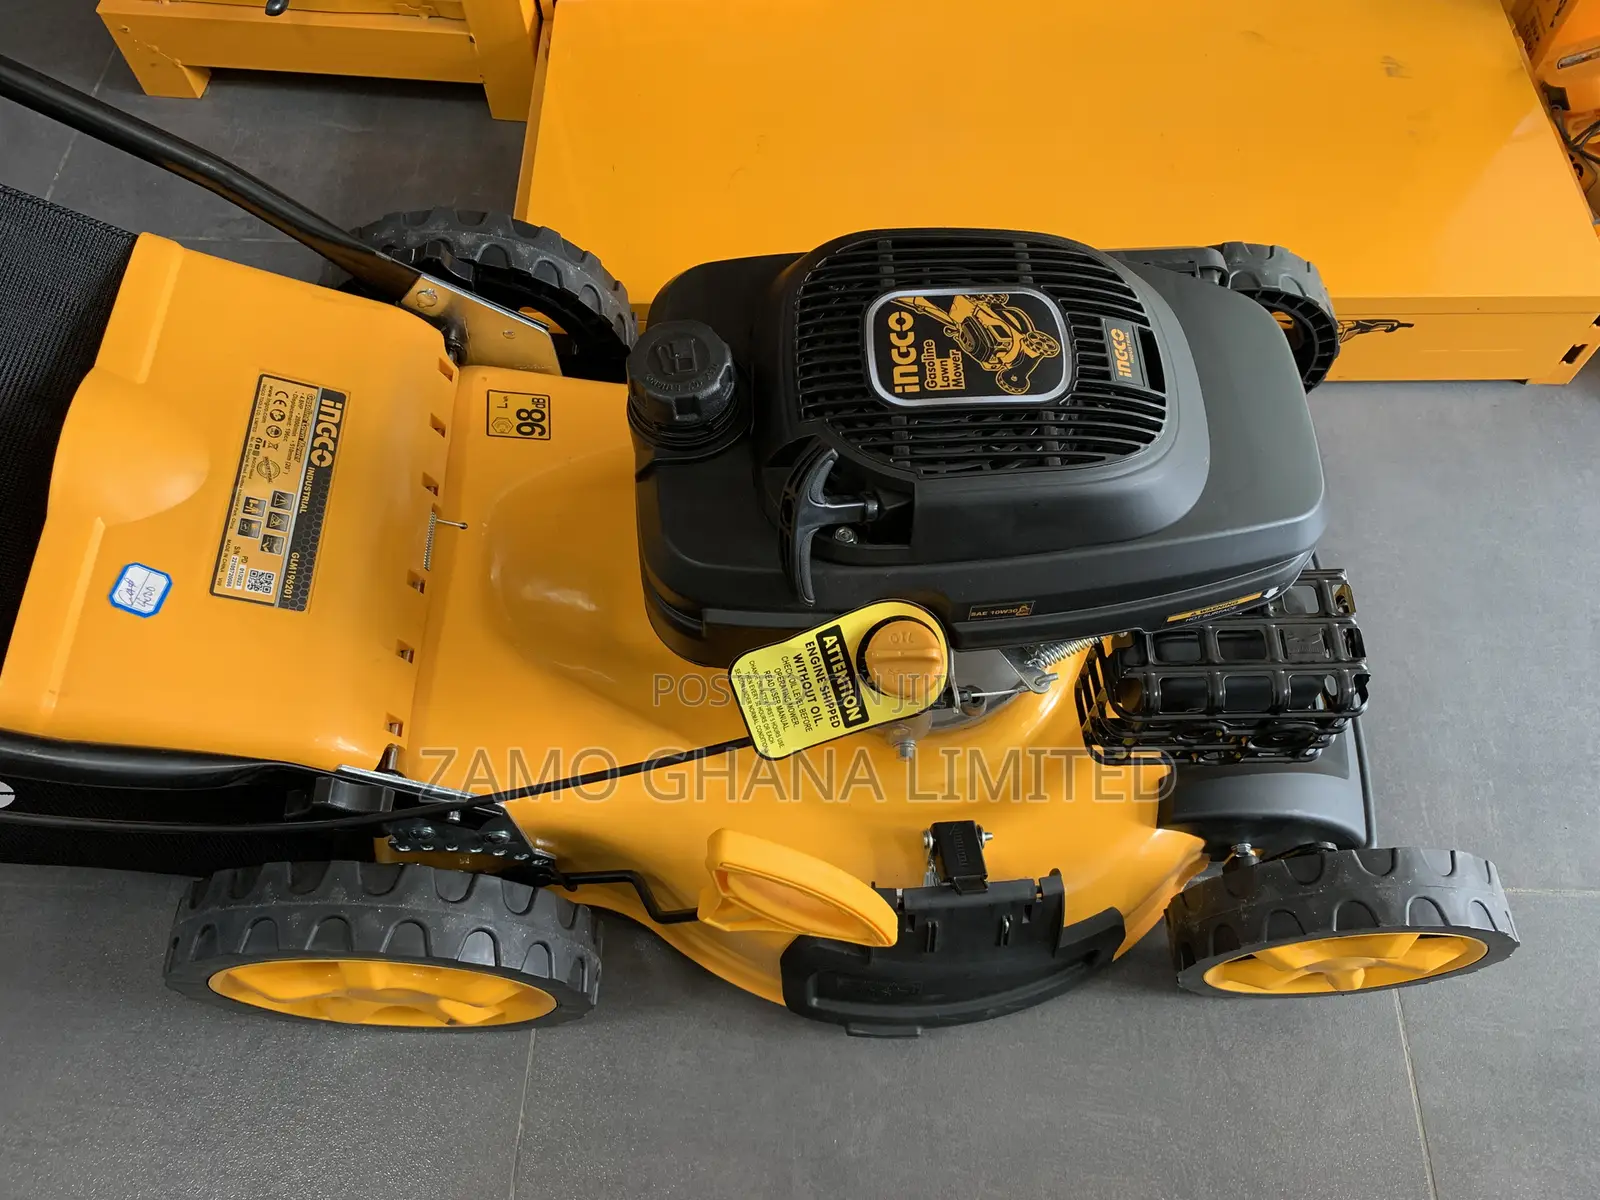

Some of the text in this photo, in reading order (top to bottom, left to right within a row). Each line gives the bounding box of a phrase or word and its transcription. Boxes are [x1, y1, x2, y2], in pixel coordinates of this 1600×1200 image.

[922, 340, 936, 388] Gasoline
[950, 349, 963, 387] Mower
[1124, 332, 1134, 363] INDUSTRIAL
[939, 359, 950, 387] Lawn
[293, 393, 314, 463] Gasoline Lawn Mower
[516, 408, 546, 436] 98
[298, 466, 315, 514] INDUSTRIAL
[240, 555, 248, 563] PD
[282, 551, 300, 599] GLM196201
[888, 631, 914, 644] OIL
[763, 669, 774, 687] READ
[769, 687, 780, 704] USER
[773, 667, 790, 702] OPERATING
[780, 655, 812, 732] CHECK OIL LEVEL BEFORE
[792, 652, 824, 726] WITHOUT OIL.
[804, 640, 841, 728] ENGINE SHIPPED
[822, 633, 862, 721] ATTENTION
